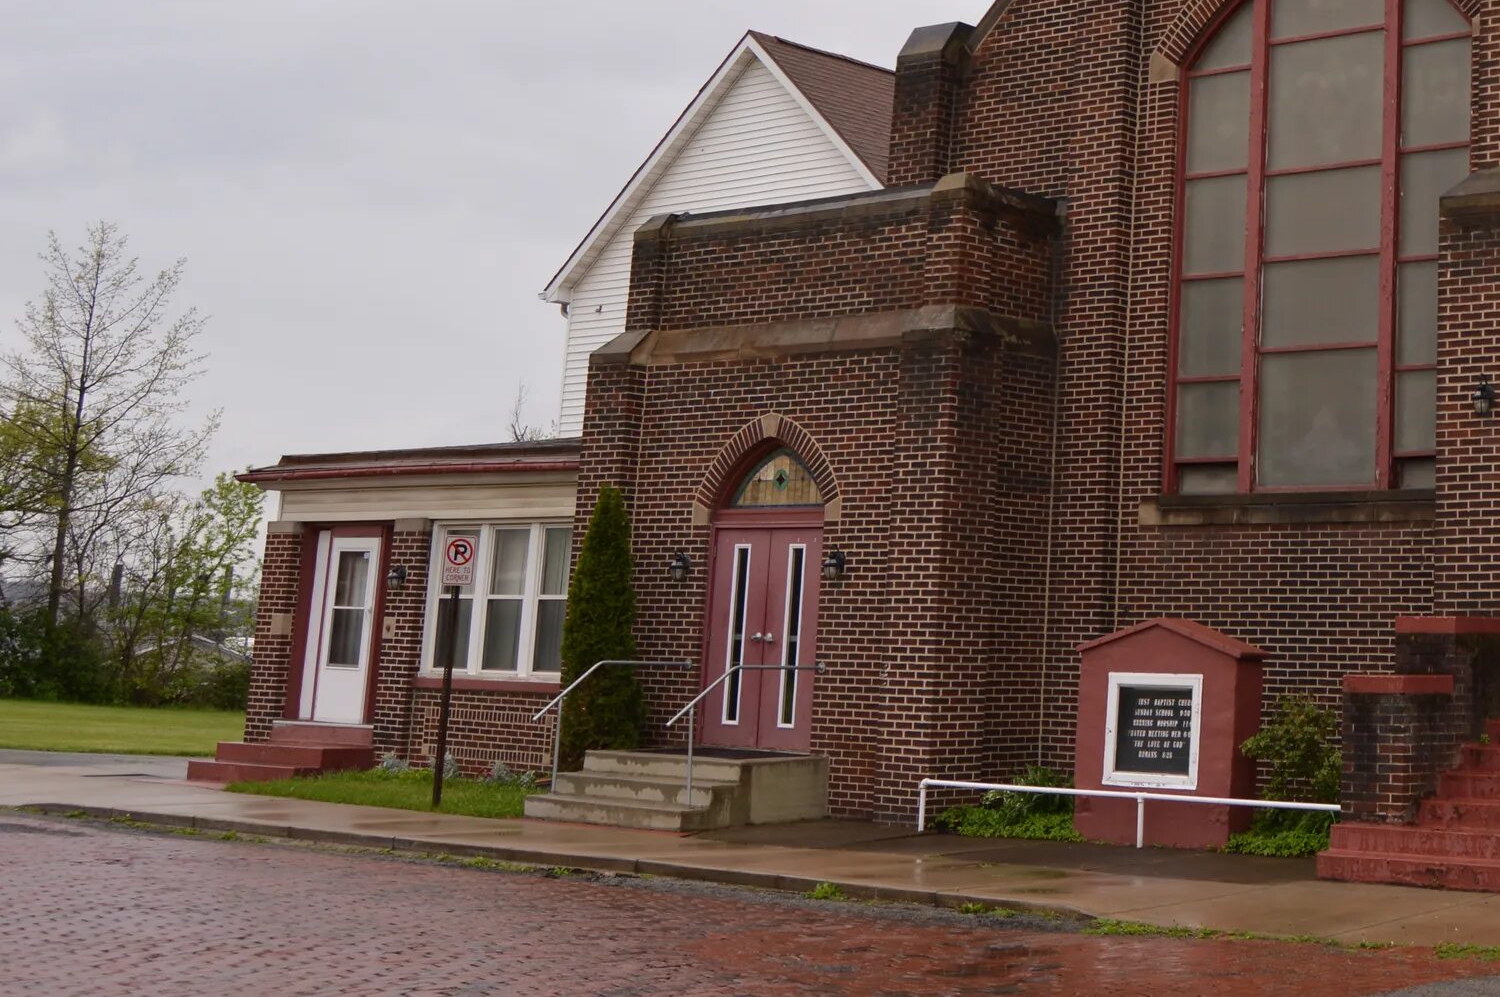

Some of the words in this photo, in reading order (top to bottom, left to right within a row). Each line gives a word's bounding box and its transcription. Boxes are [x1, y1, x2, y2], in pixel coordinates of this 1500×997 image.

[445, 566, 460, 574] HERE
[463, 566, 471, 574] TO
[446, 574, 470, 582] CORNER
[1154, 698, 1175, 706] BAPTIST
[1134, 708, 1153, 717] SUNDAY
[1155, 709, 1174, 717] SCHOOL
[1156, 720, 1178, 728] WORSHIP
[1148, 730, 1169, 738] MEETING
[1147, 740, 1161, 748] LOVE
[1163, 741, 1171, 749] OF
[1138, 750, 1158, 759] ROMANS
